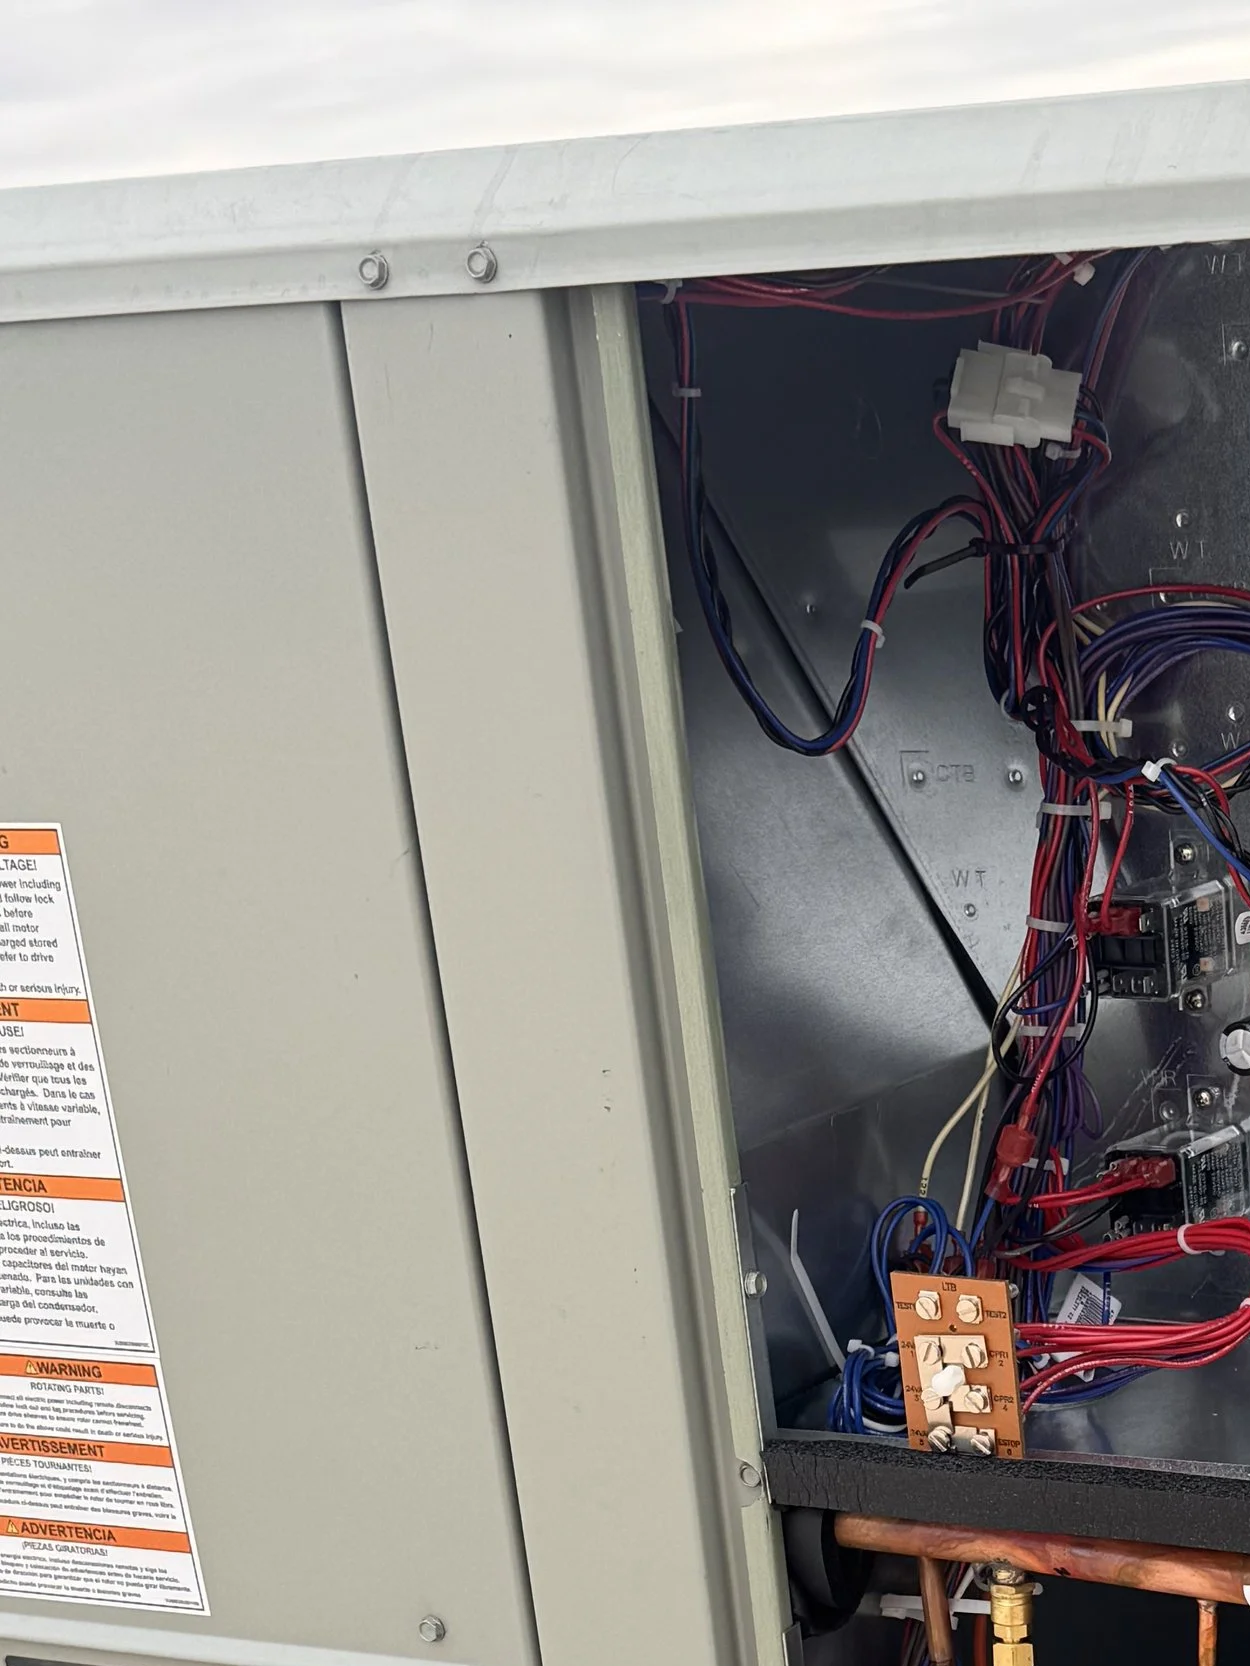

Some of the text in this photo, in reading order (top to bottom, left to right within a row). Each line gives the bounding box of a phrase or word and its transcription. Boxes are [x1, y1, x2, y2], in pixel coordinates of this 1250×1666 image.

[20, 879, 61, 891] including
[4, 893, 55, 904] follow lock
[3, 908, 33, 918] before
[12, 924, 39, 933] motor
[28, 938, 58, 948] stored
[19, 952, 54, 962] to drive
[20, 984, 52, 993] serious
[43, 1088, 66, 1098] Dans
[51, 1118, 71, 1128] pour
[39, 1148, 59, 1158] peut
[32, 1219, 65, 1230] incluso
[942, 1282, 957, 1292] LTB
[985, 1310, 1007, 1319] TEST2
[990, 1351, 1009, 1359] CPR1
[37, 1361, 102, 1378] WARNING
[30, 1382, 72, 1393] ROTATING
[20, 1521, 117, 1542] ADVERTENCIA
